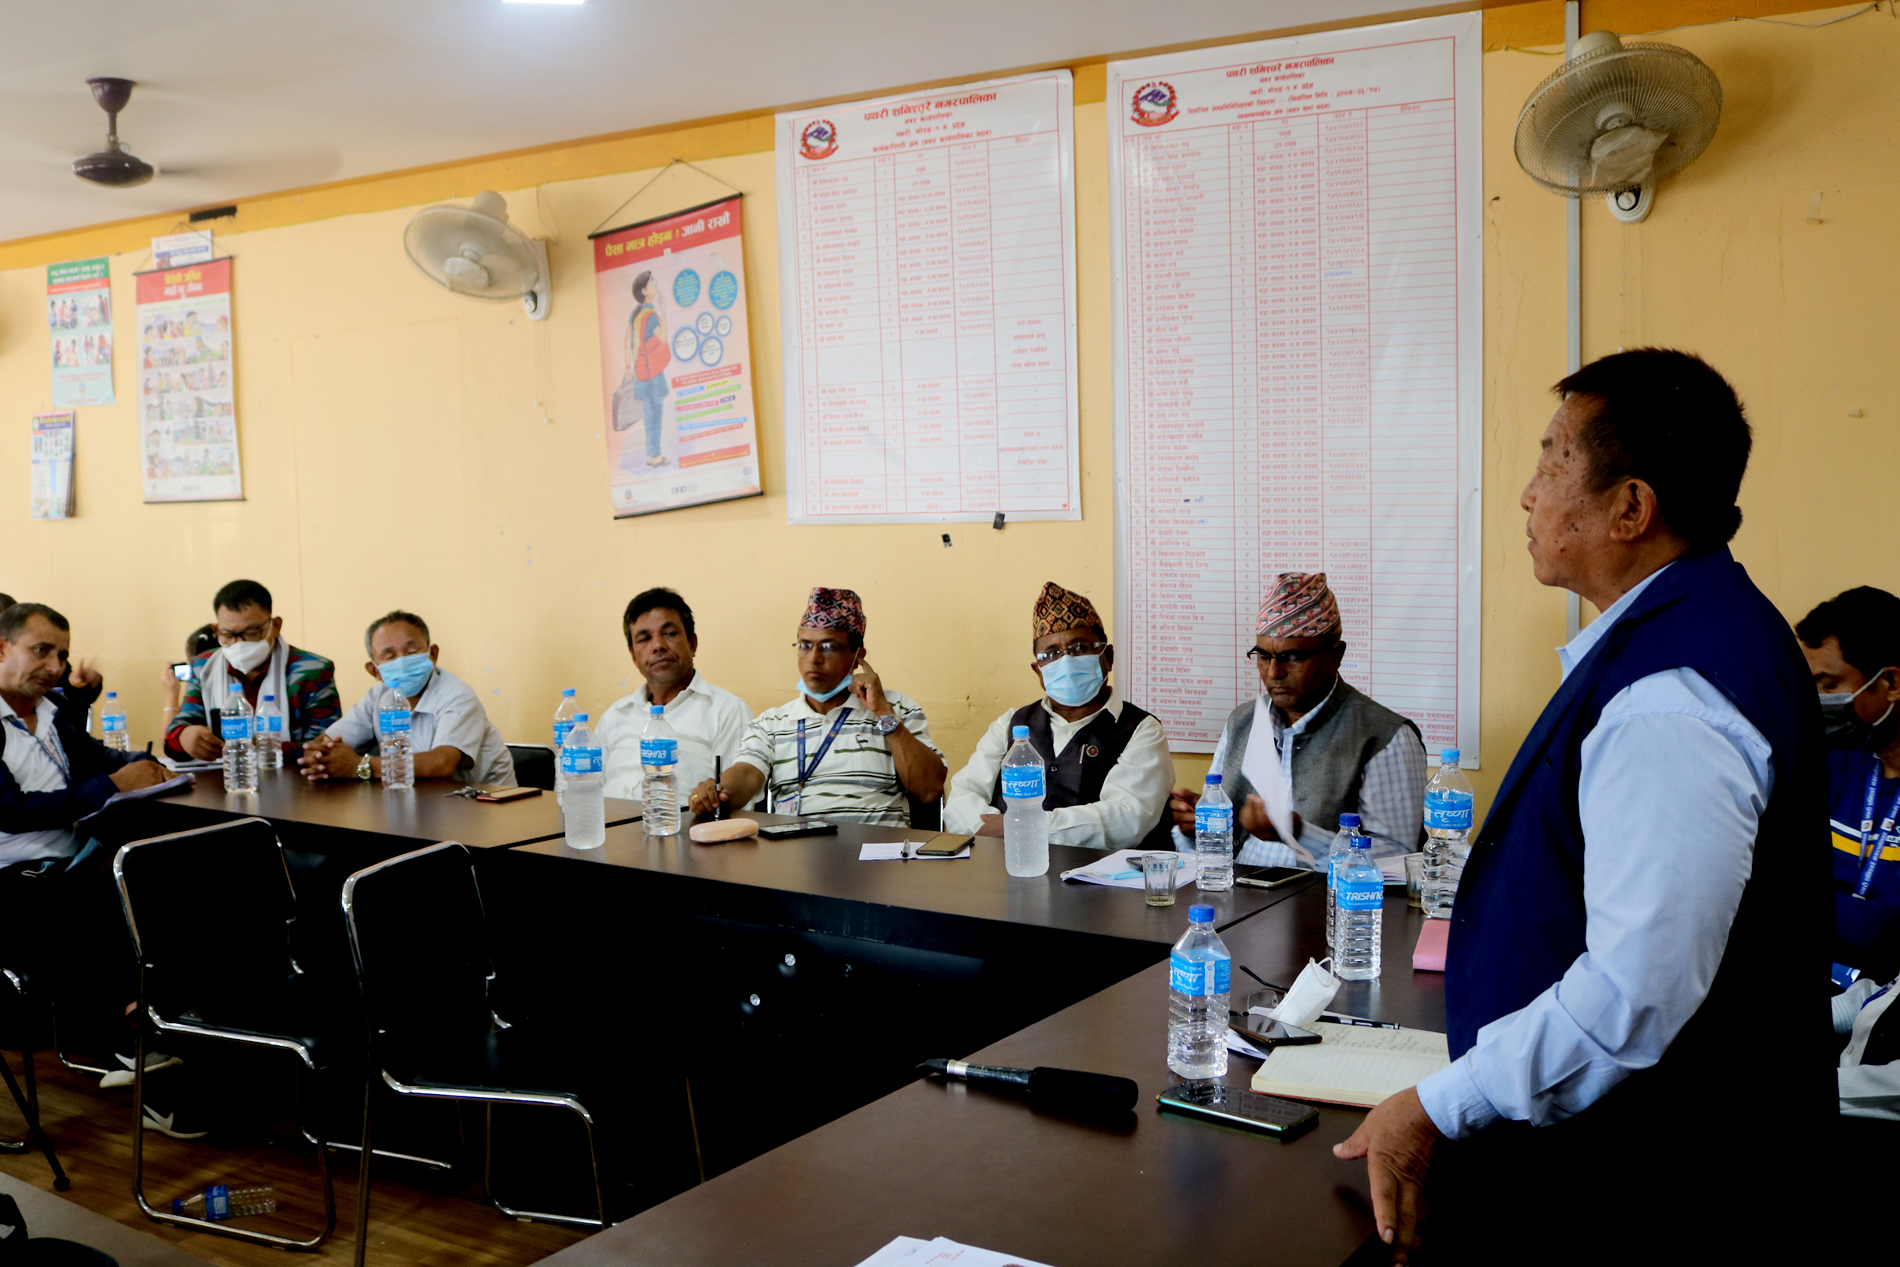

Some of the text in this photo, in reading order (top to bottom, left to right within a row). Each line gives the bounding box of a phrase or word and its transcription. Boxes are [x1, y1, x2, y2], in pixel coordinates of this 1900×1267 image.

[1284, 57, 1334, 70] नगरपालिका
[934, 92, 996, 108] नगरपालिका
[606, 243, 623, 257] पैसा
[626, 238, 645, 251] मात्र
[647, 230, 672, 247] होइन
[681, 219, 705, 237] जानी
[1008, 779, 1040, 792] तृष्णा
[1434, 809, 1470, 822] तृष्णा
[1174, 966, 1203, 982] तृष्णा
